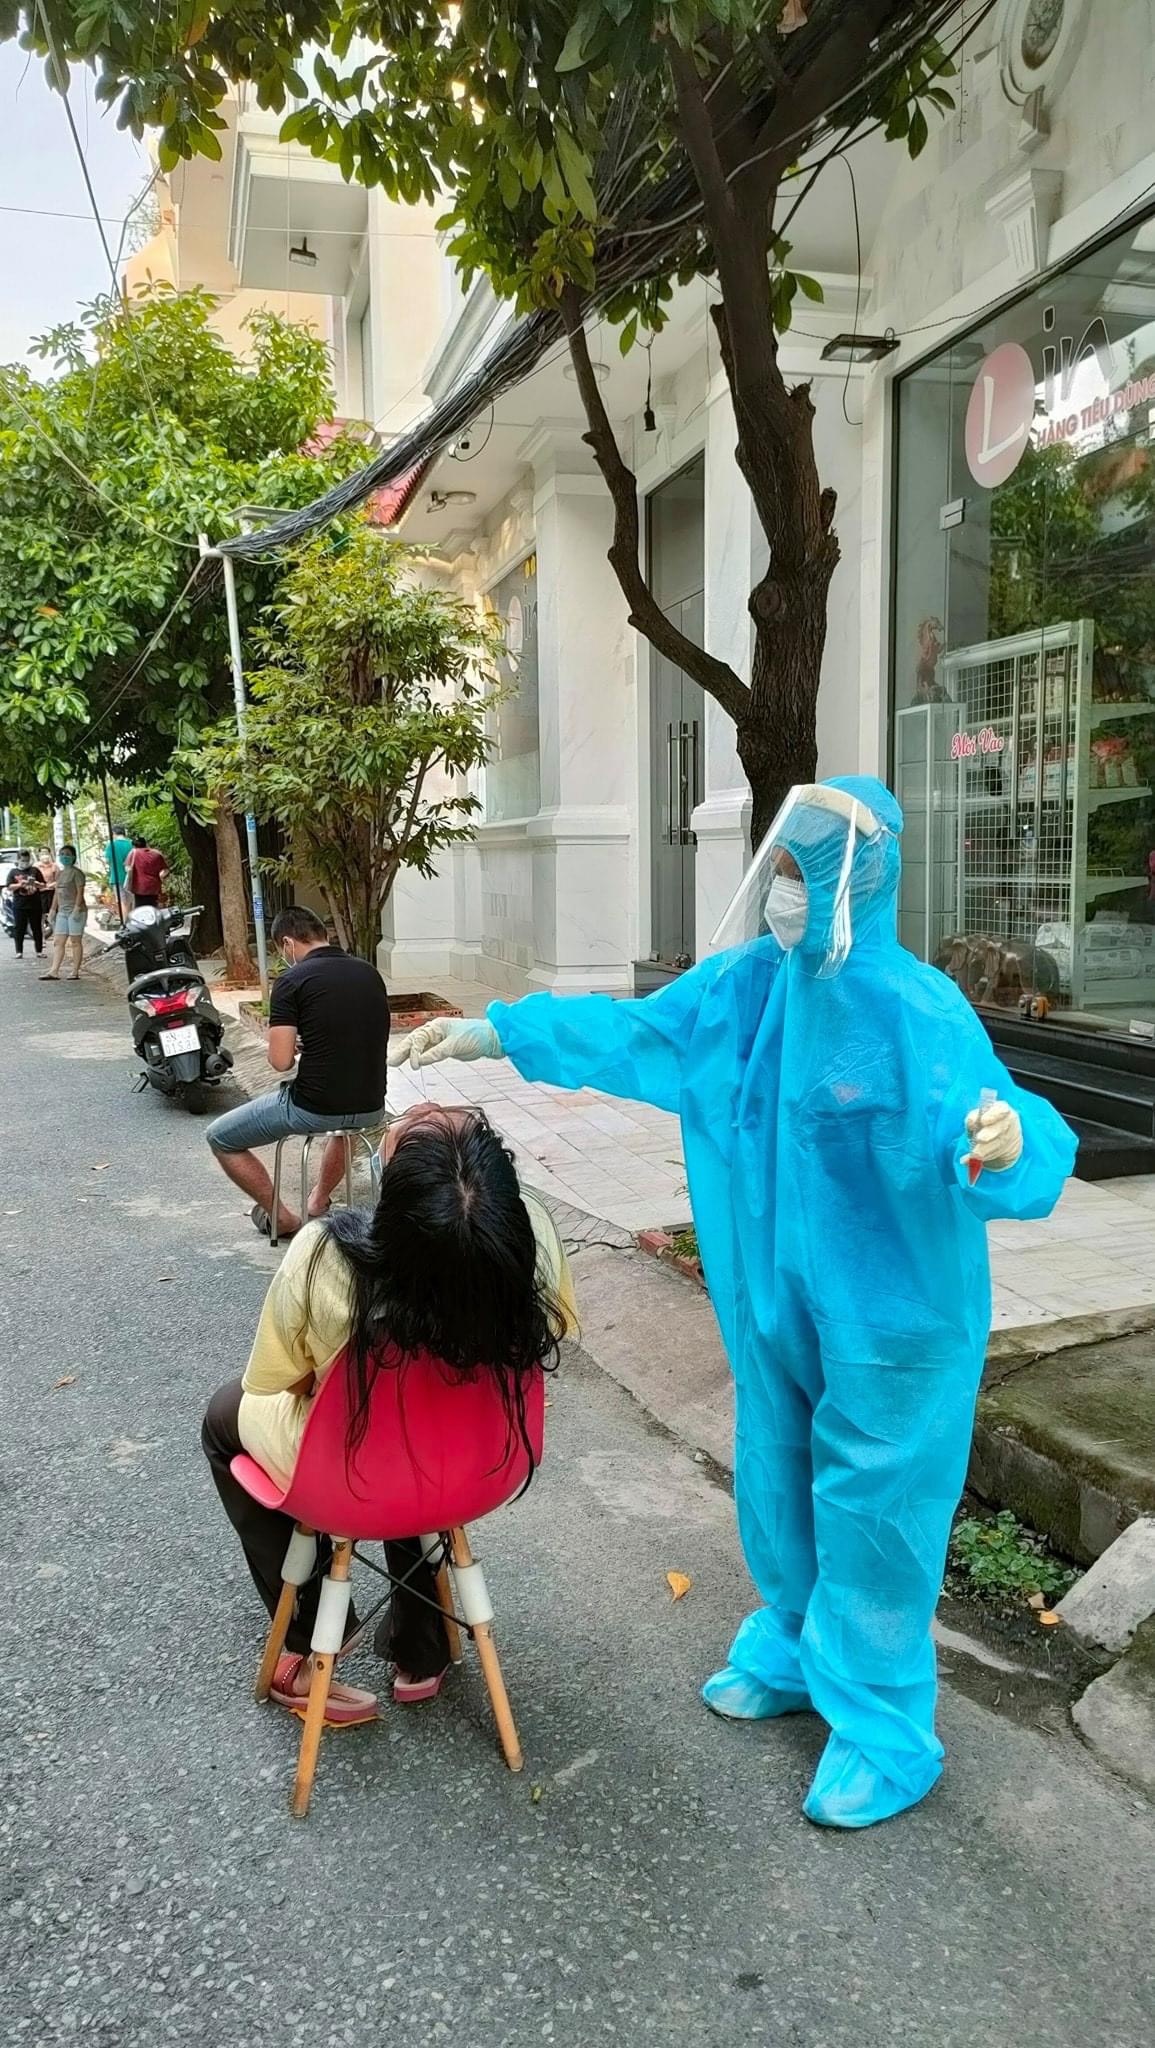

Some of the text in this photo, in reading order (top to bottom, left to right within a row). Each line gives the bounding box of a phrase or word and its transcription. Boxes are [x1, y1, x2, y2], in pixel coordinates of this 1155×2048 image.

[1038, 413, 1078, 449] HÀNG
[1081, 396, 1109, 429] TIÊU
[978, 727, 1004, 754] Vào
